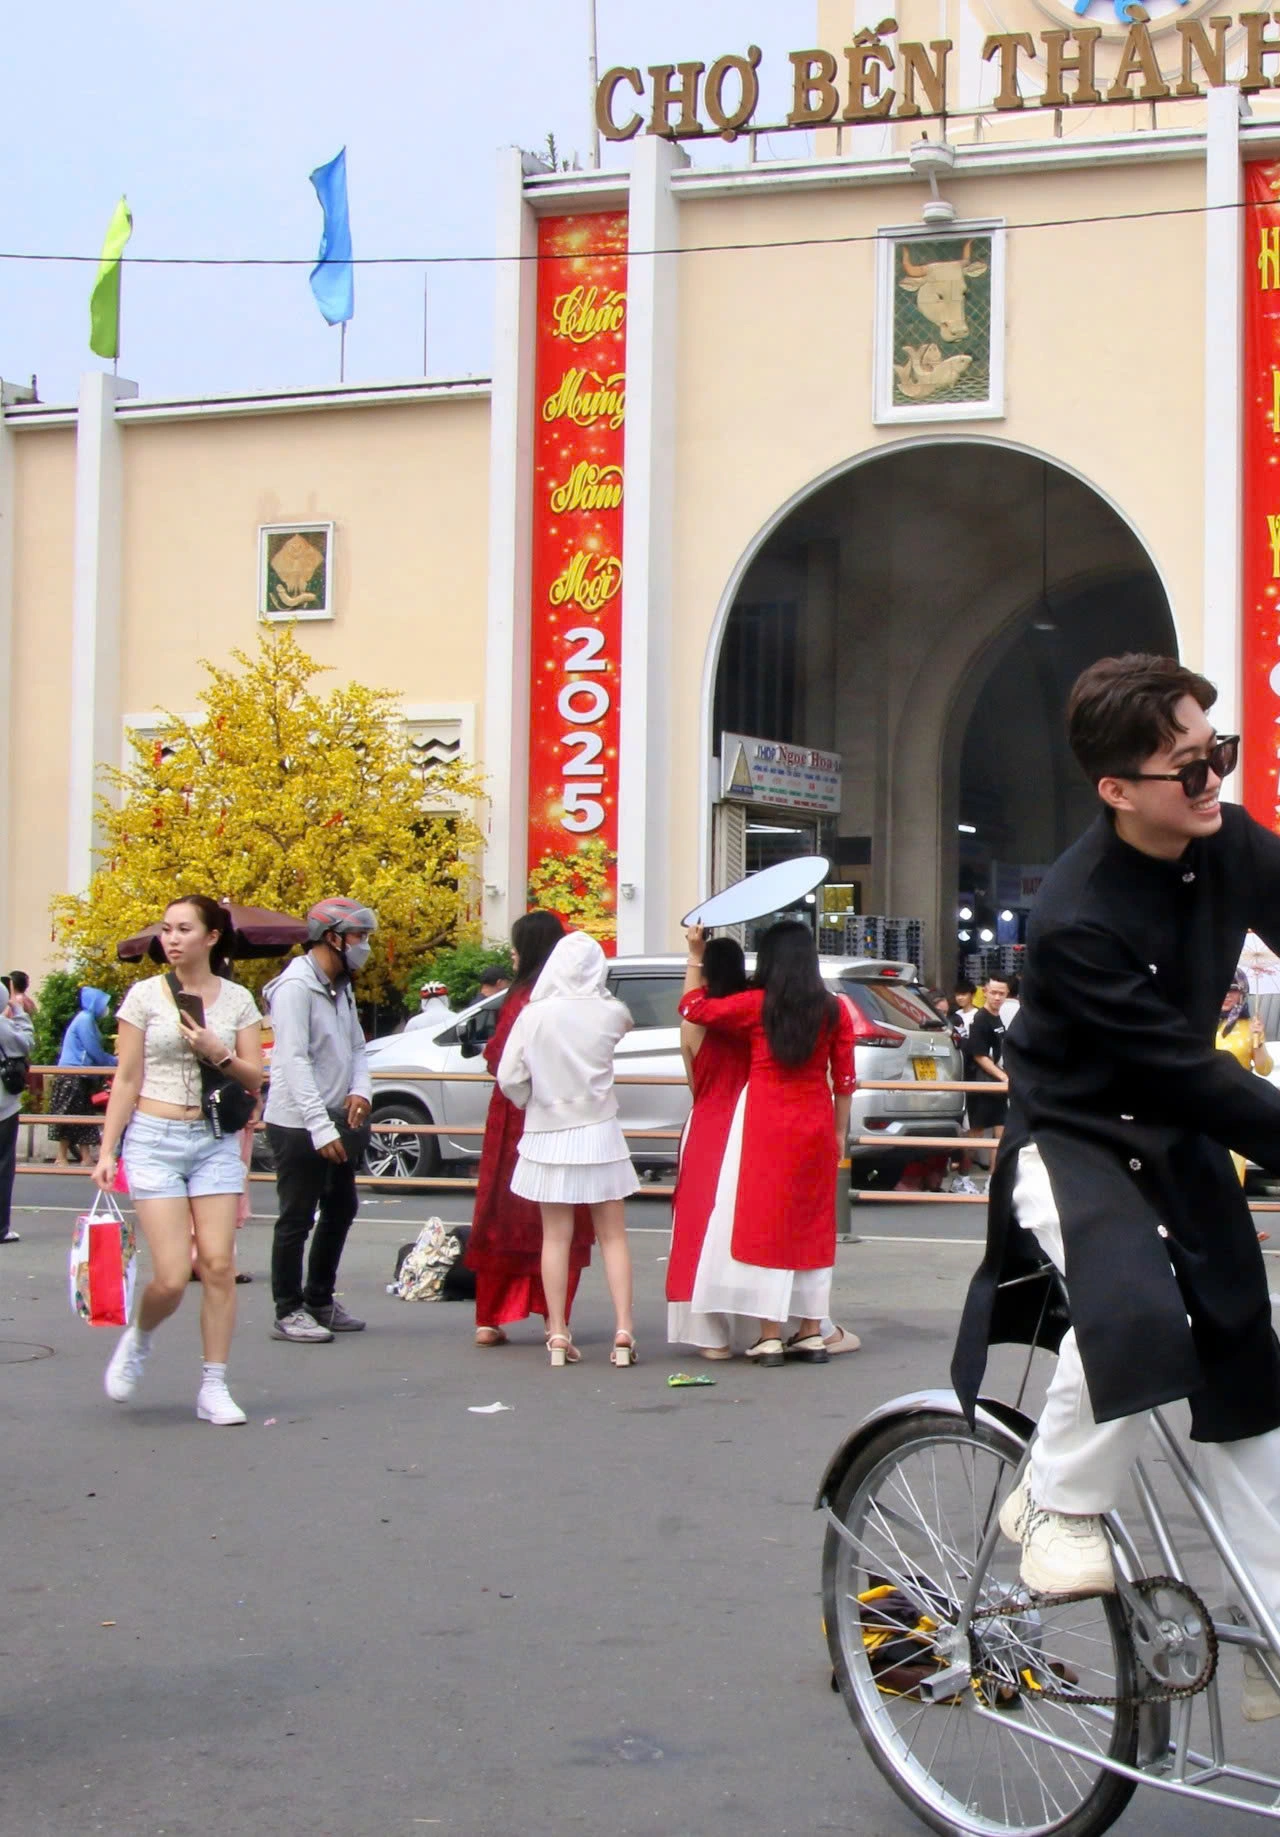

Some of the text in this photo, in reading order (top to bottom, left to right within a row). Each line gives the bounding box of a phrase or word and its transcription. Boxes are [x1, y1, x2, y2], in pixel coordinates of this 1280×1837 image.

[595, 45, 762, 142] CHỢ
[788, 18, 953, 125] BẾN
[553, 285, 627, 343] Chúc
[543, 367, 626, 430] Mừng
[551, 460, 624, 513] Năm
[549, 551, 623, 613] Mới
[557, 627, 610, 832] 2025
